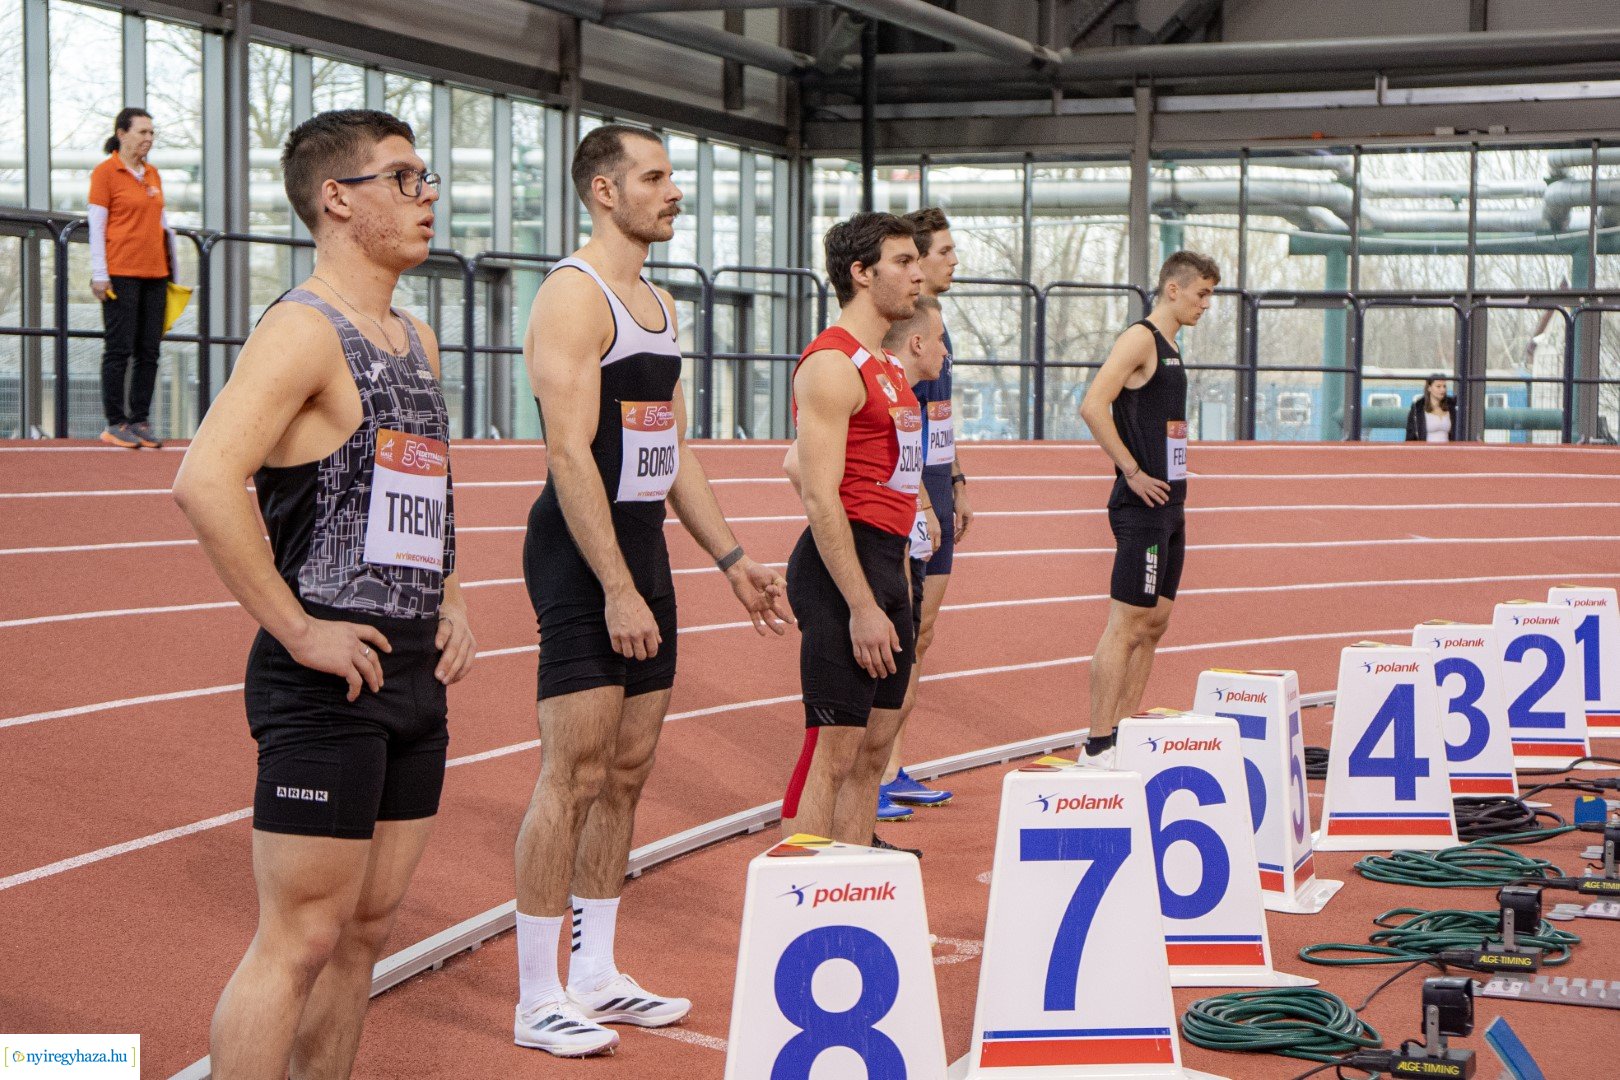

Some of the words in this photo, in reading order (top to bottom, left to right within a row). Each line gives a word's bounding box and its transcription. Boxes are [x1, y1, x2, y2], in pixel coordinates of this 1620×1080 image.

[401, 439, 428, 469] 50
[637, 444, 676, 477] BOROS
[1144, 551, 1158, 594] SVSE
[1573, 597, 1607, 608] polanik
[1522, 615, 1560, 626] polanik
[1444, 637, 1485, 649] polanik
[1375, 661, 1420, 675] polanik
[1574, 615, 1601, 701] 1
[1503, 633, 1566, 729] 2
[1226, 690, 1268, 704] polanik
[1434, 657, 1490, 762] 3
[1163, 737, 1222, 754] polanik
[1348, 683, 1430, 801] 4
[1288, 710, 1304, 845] 5
[276, 786, 328, 802] ARAK
[1055, 793, 1124, 814] polanik
[1144, 765, 1230, 920] 6
[812, 881, 897, 908] polanik
[1019, 827, 1132, 1012] 7
[1479, 955, 1532, 966] ALGE-TIMING
[769, 924, 908, 1080] 8
[1397, 1061, 1460, 1075] ALGE-TIMING
